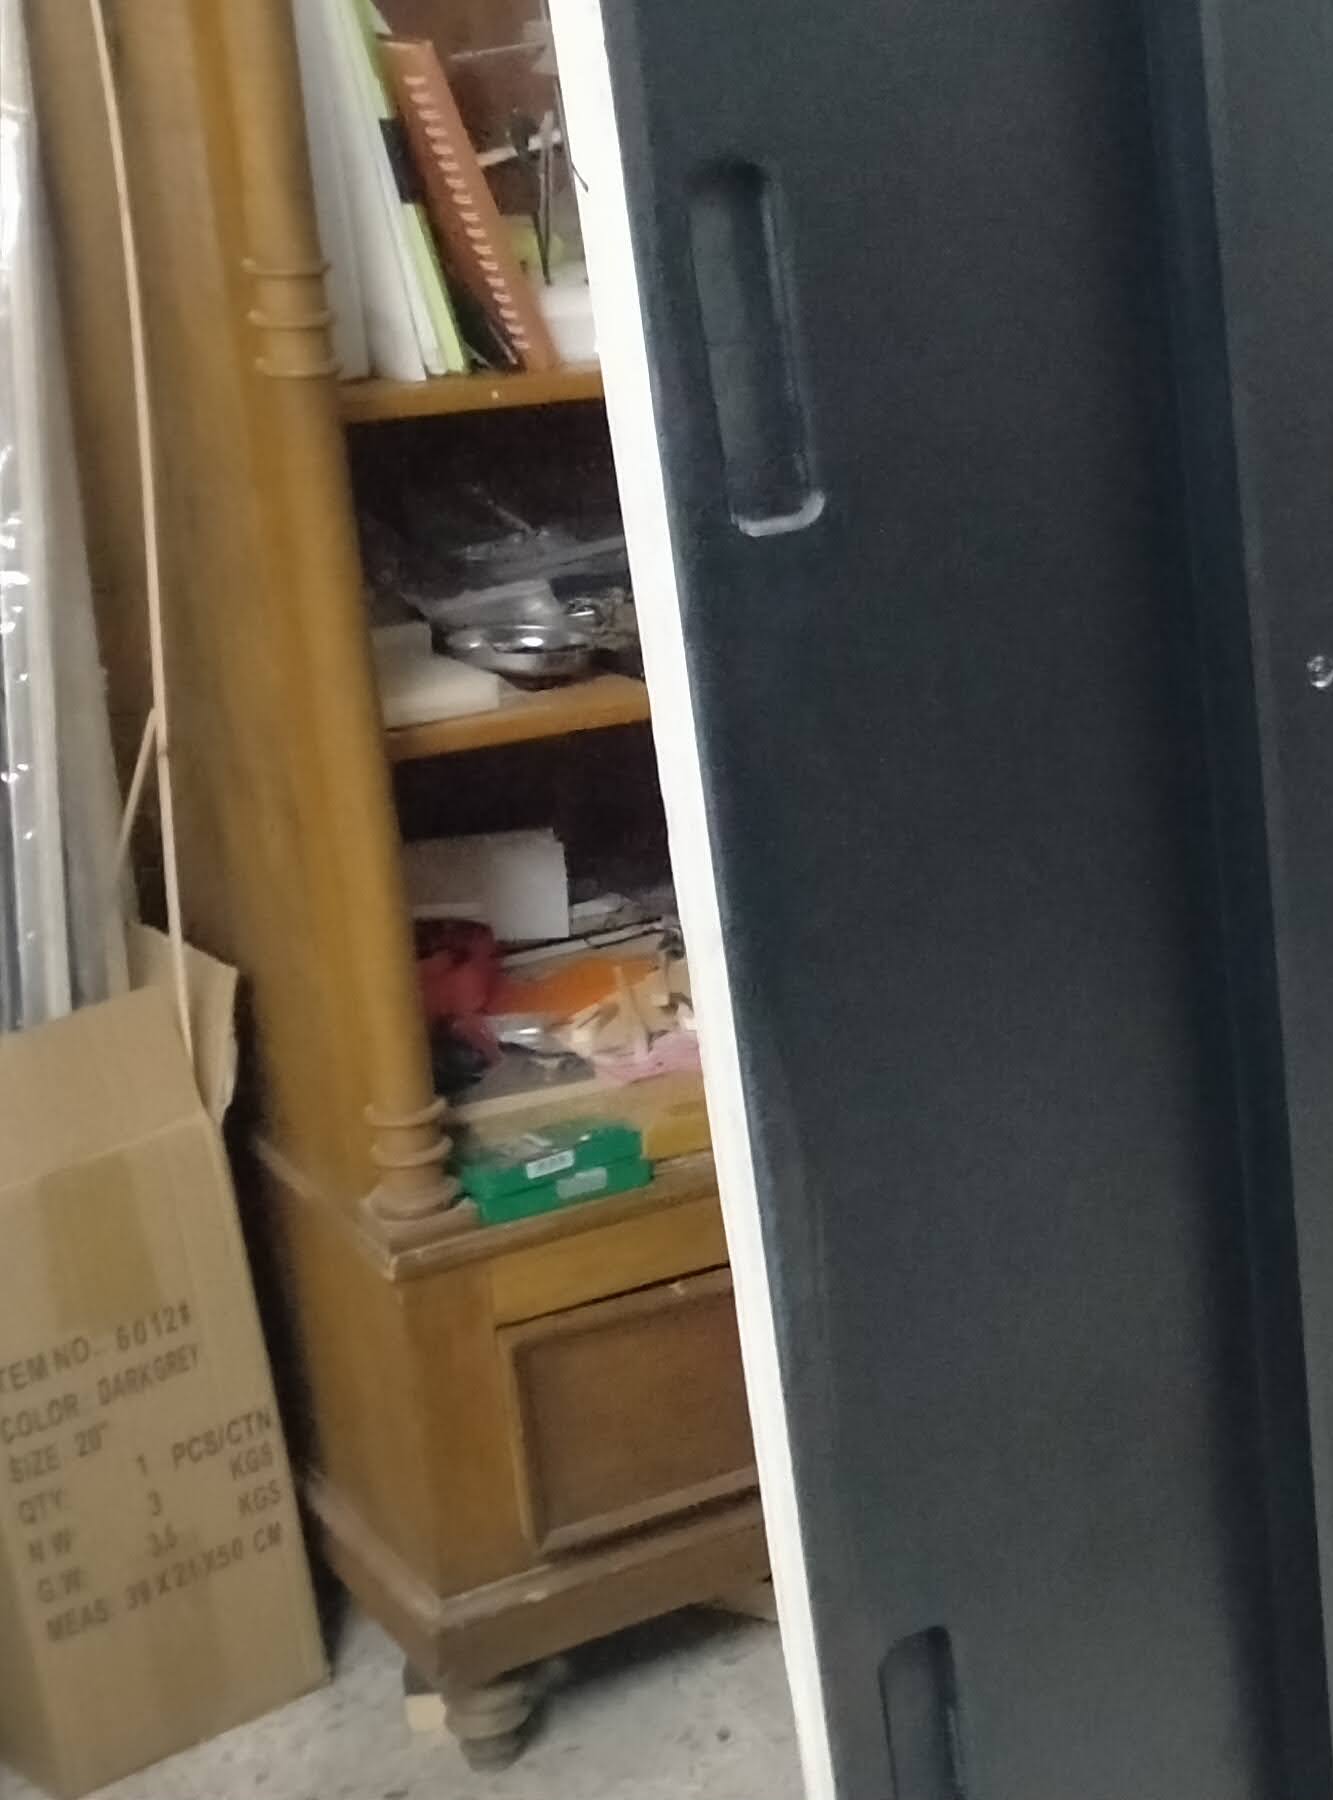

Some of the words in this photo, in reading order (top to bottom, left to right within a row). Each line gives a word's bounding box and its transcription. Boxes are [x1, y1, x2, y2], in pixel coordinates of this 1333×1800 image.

[0, 1350, 49, 1393] TEM
[135, 1452, 148, 1477] 1
[170, 1410, 272, 1471] PCS/CTN
[146, 1488, 164, 1517] 3
[228, 1439, 274, 1480] KGS
[237, 1479, 283, 1519] KGS
[253, 1520, 283, 1554] CM
